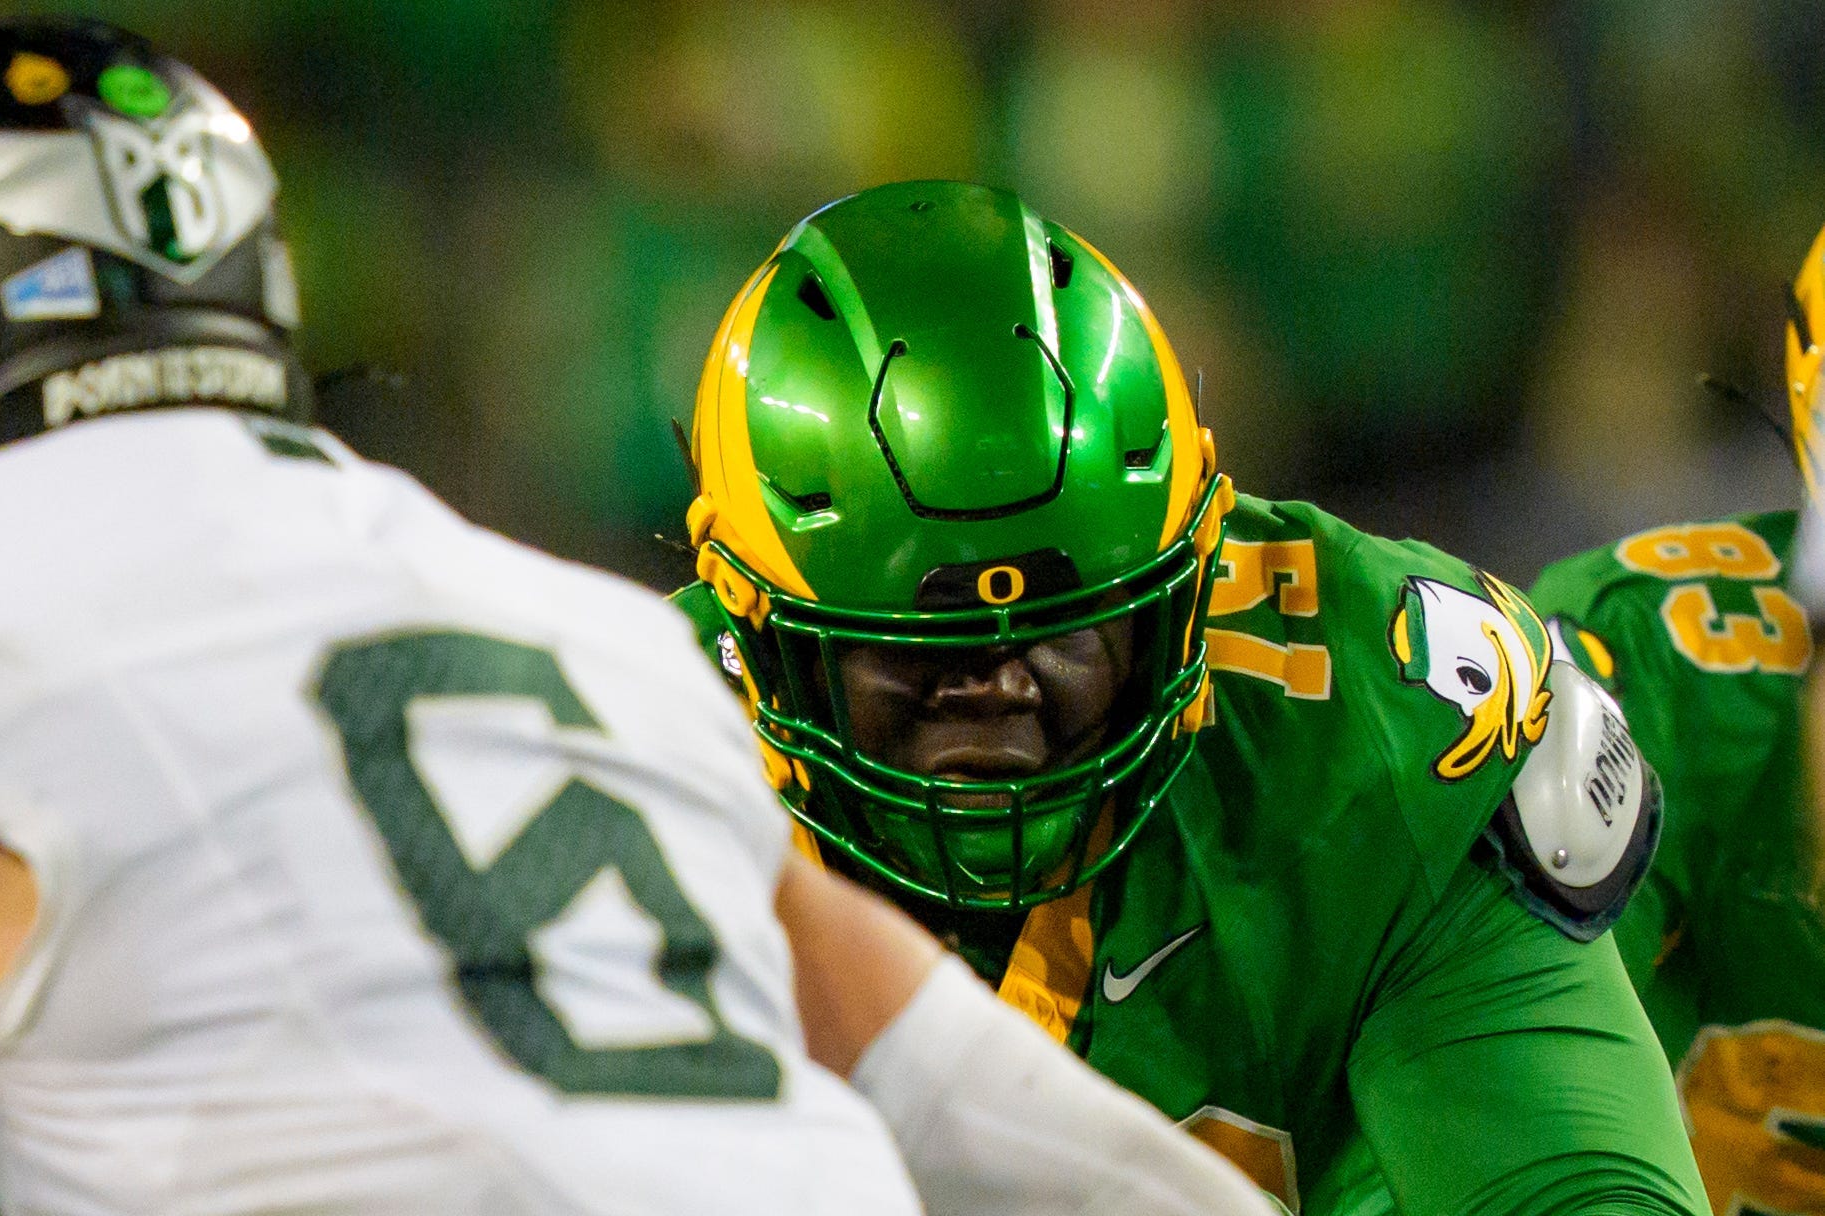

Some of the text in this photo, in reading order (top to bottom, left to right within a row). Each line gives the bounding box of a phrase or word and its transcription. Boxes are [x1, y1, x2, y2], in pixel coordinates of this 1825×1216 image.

[977, 565, 1024, 605] O
[1615, 521, 1814, 676] 83
[310, 625, 785, 1098] 6
